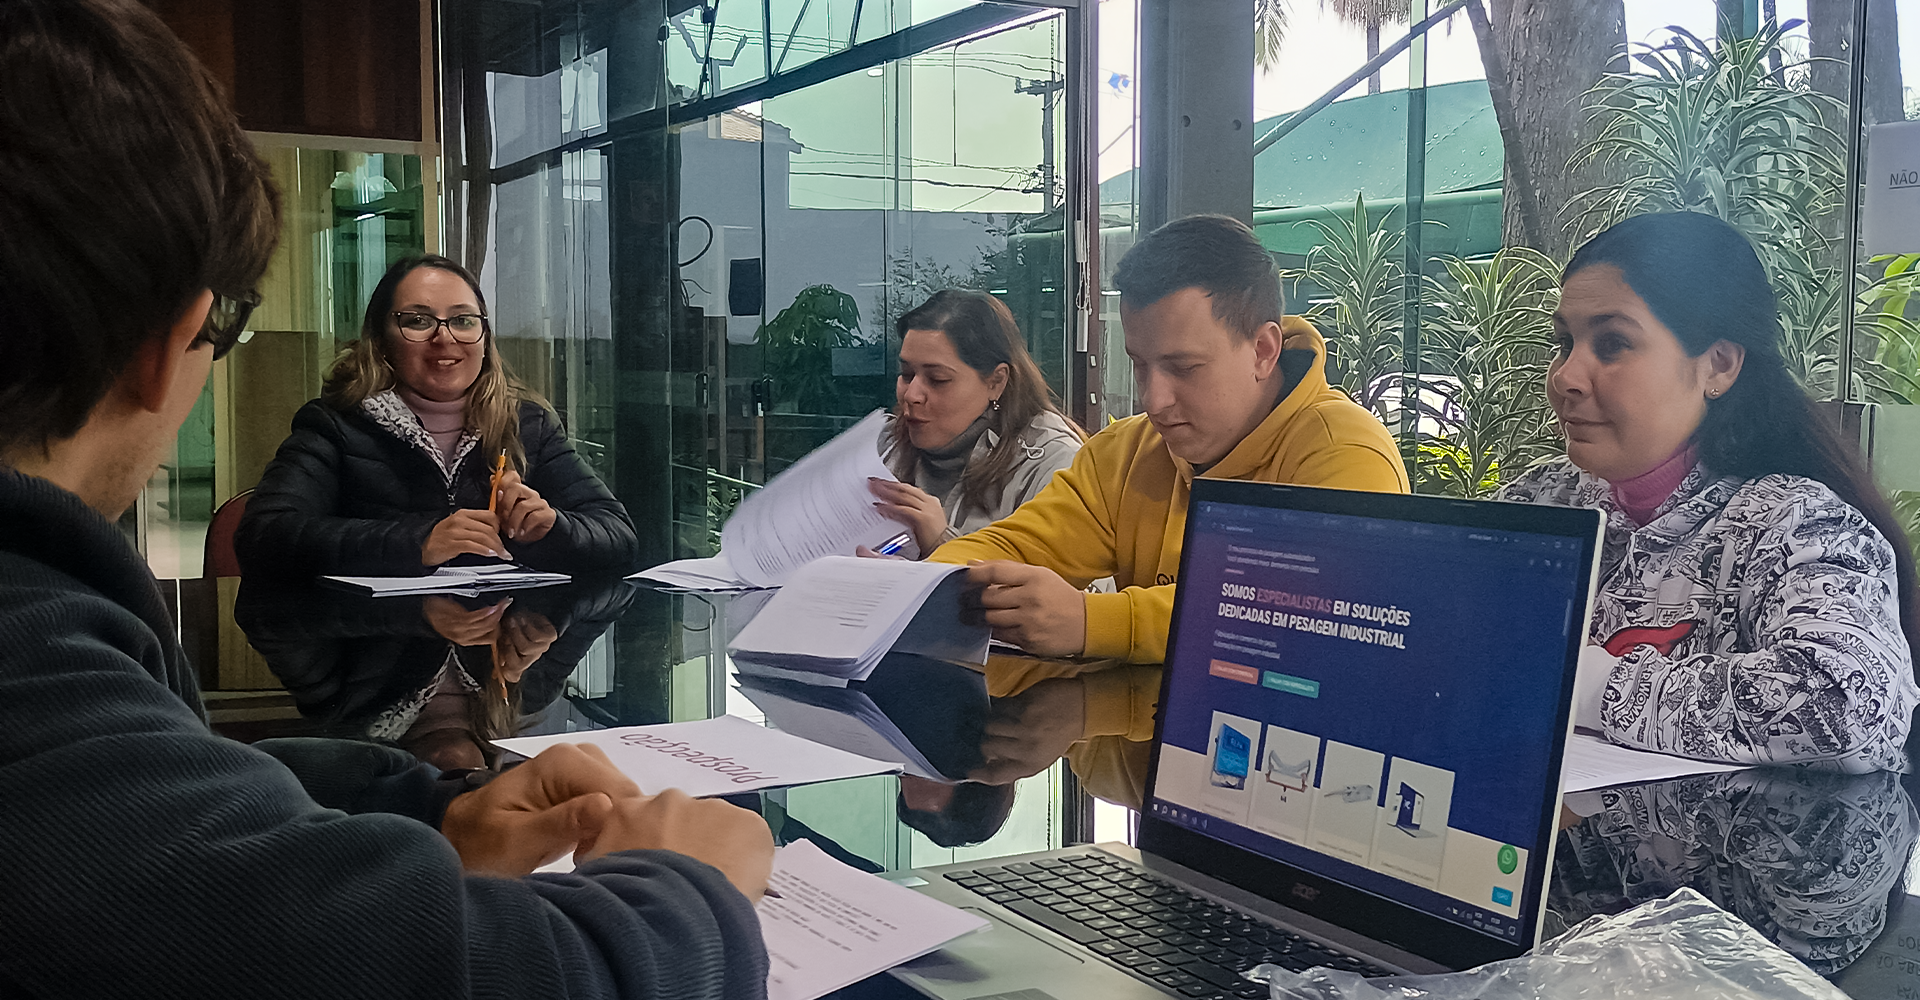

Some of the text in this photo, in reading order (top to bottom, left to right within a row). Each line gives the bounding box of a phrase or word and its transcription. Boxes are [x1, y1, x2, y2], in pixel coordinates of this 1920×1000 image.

[1890, 169, 1918, 185] NÃO
[1218, 602, 1406, 650] DEDICADAS EM PESAGEM INDUSTRIAL
[1221, 583, 1411, 627] SOMOS ESPECIALISTAS EM SOLUÇÕES
